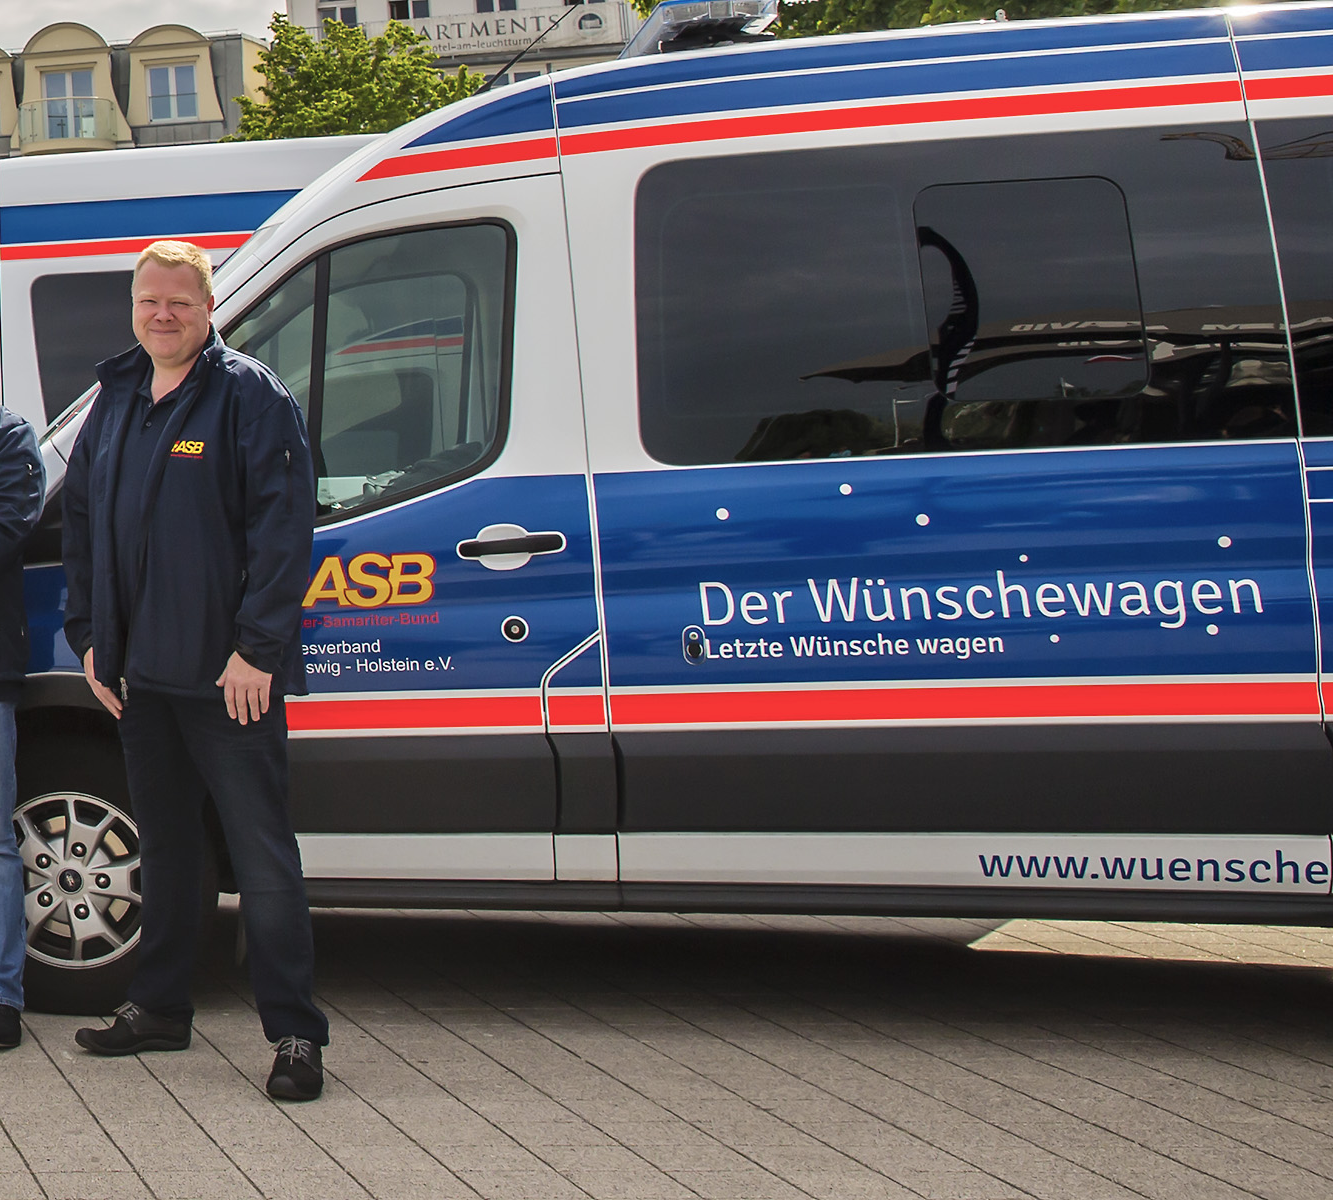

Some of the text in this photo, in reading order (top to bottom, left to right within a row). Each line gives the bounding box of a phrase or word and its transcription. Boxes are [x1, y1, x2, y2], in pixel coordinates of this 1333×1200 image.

[432, 37, 547, 52] otel-am-leuchtturme
[175, 440, 205, 455] ASB
[301, 551, 437, 609] ASB
[699, 569, 1264, 629] Der Wünschewagen
[302, 611, 440, 629] er-Samariter-Bund
[302, 639, 381, 656] esverband
[704, 633, 1005, 660] Letzte Wünsche wagen
[356, 657, 420, 673] Holstein
[424, 656, 455, 672] e.V.
[979, 850, 1329, 884] www.wuensche
